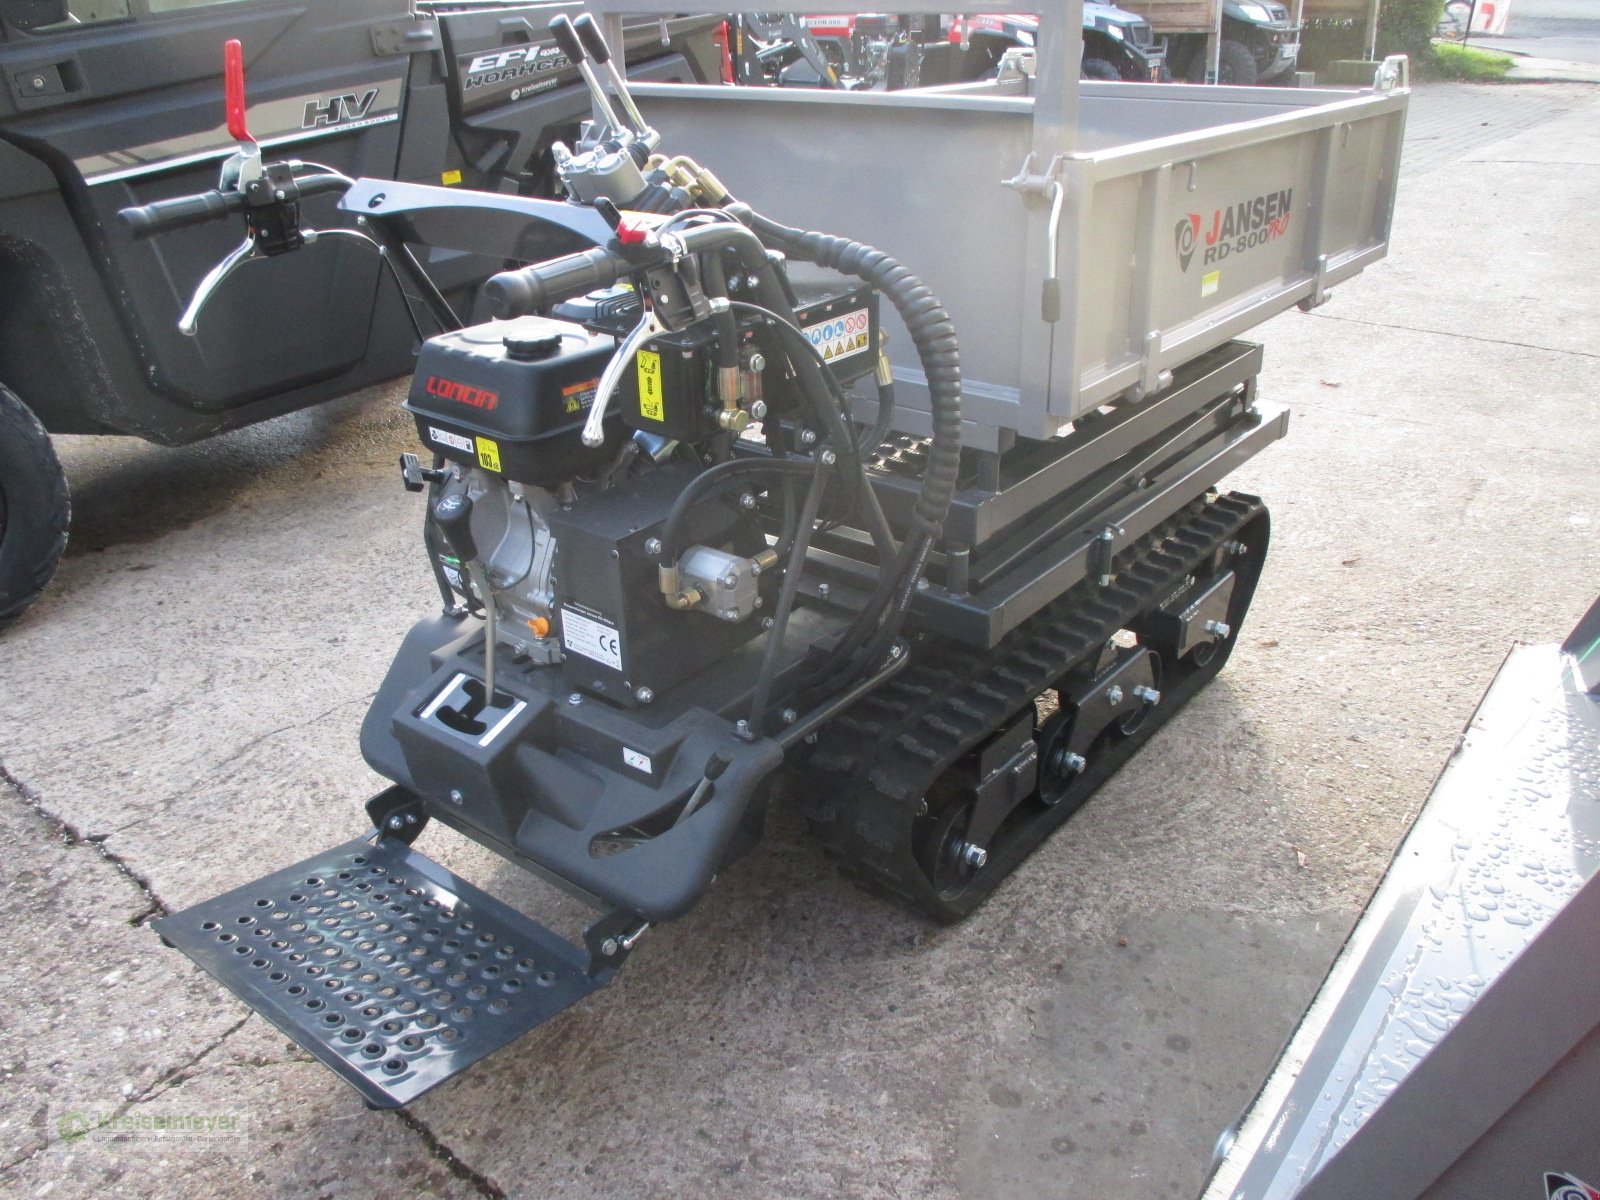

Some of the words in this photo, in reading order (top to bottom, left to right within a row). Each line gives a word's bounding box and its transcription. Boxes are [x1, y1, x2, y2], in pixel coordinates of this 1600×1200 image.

[468, 46, 540, 74] EFI
[302, 88, 379, 129] HV
[1205, 188, 1293, 246] JANSEN
[425, 375, 498, 412] LONCIN
[480, 452, 494, 469] 103
[599, 634, 618, 656] CE
